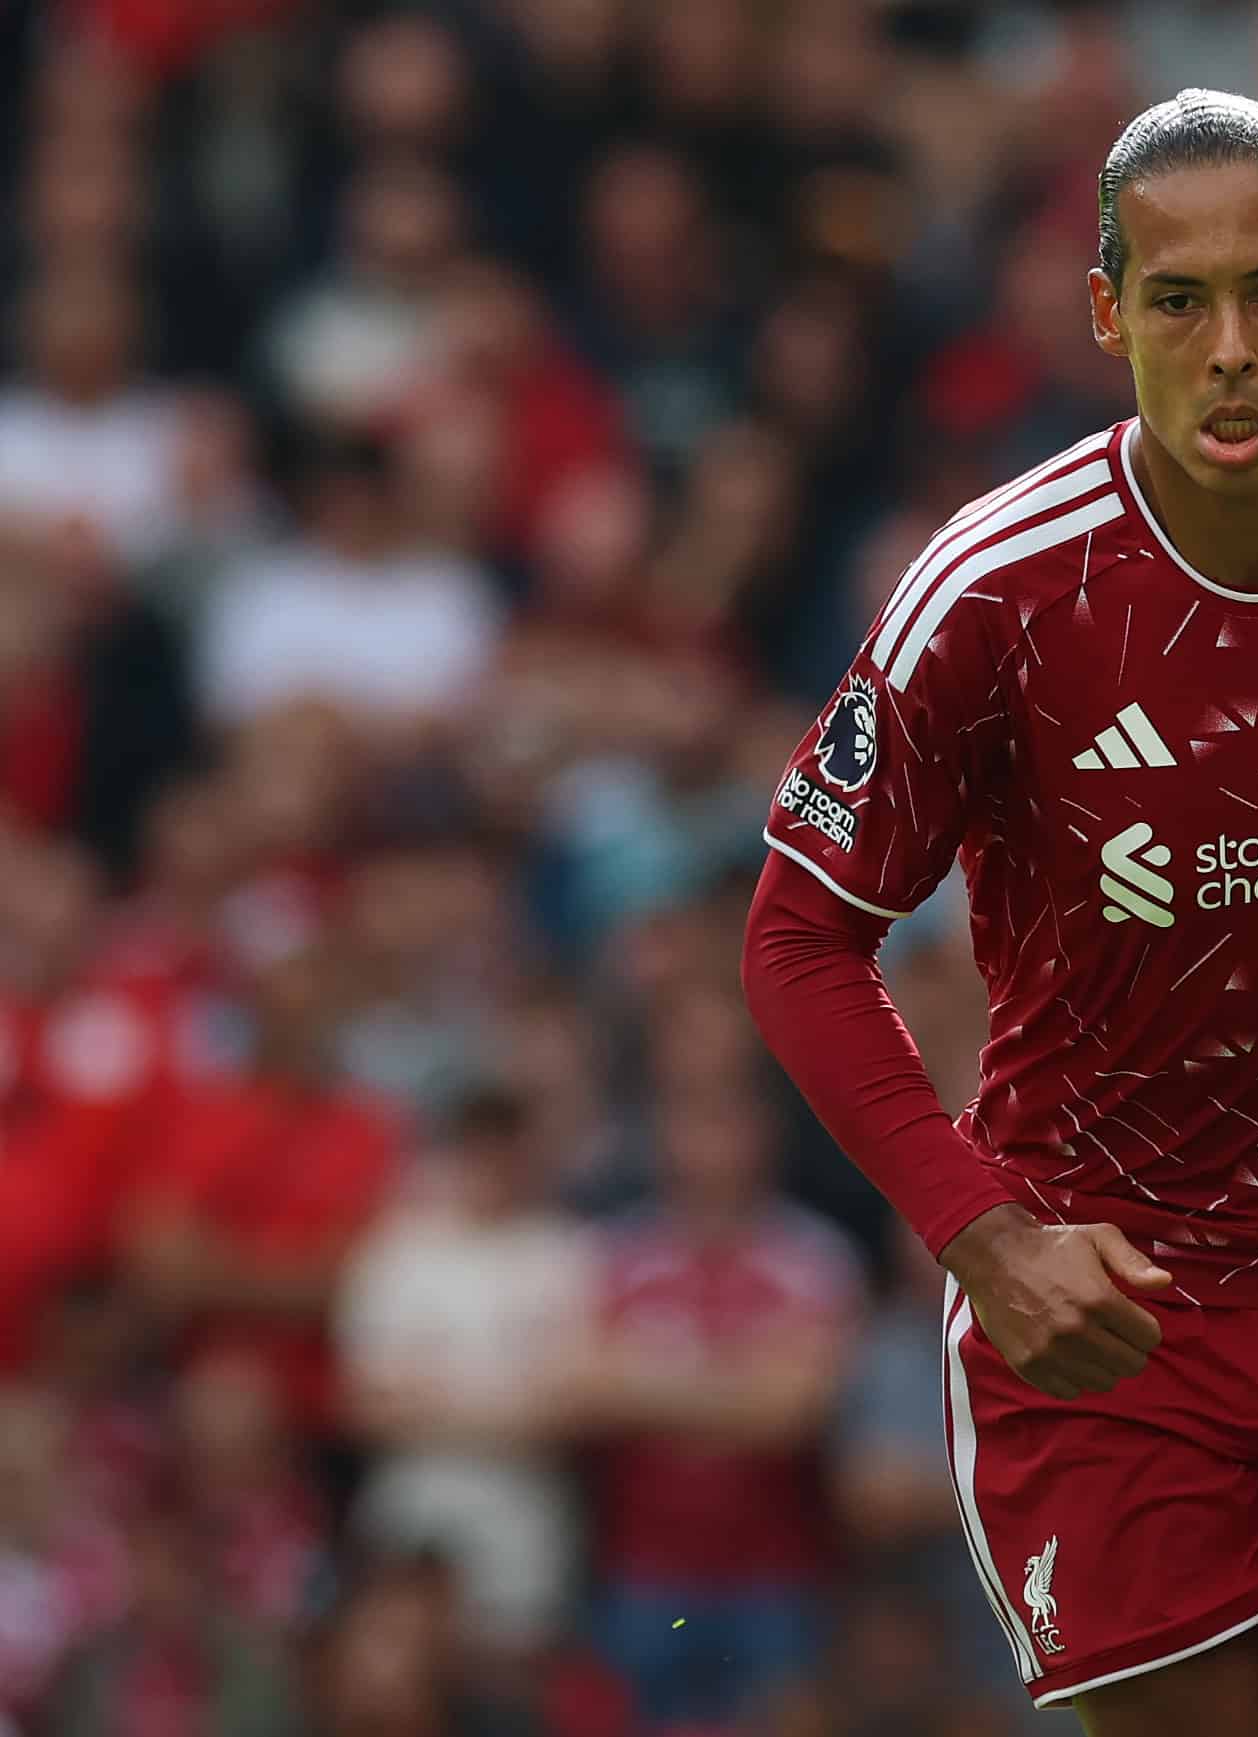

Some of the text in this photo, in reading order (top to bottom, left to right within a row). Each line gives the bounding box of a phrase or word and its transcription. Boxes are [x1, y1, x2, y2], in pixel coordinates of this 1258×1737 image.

[786, 767, 855, 832] No room
[800, 803, 853, 853] racism
